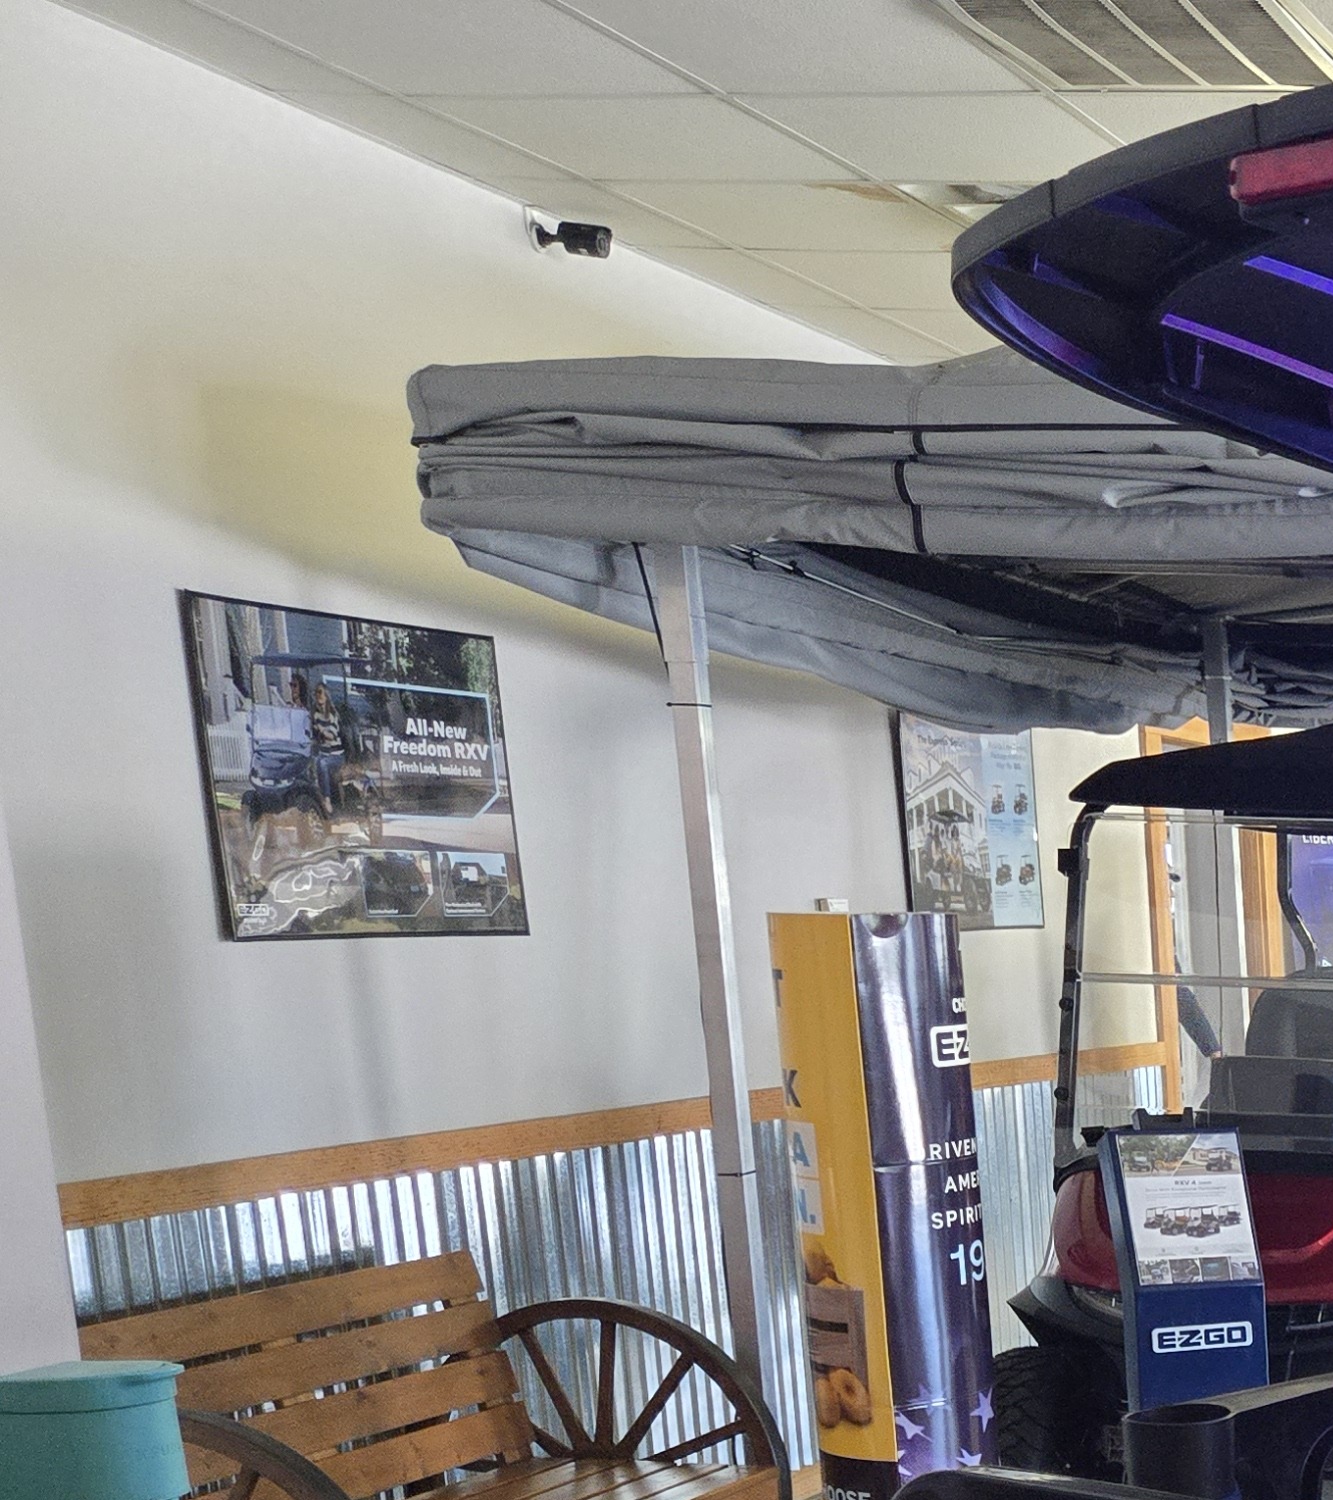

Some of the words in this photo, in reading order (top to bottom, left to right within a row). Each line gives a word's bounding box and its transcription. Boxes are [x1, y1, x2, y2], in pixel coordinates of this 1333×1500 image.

[405, 717, 468, 740] All-New
[383, 735, 452, 759] Freedom
[454, 742, 490, 761] RXV
[391, 760, 398, 773] A
[398, 761, 419, 774] Fresh
[440, 764, 462, 777] Inside
[469, 766, 482, 778] Out
[1157, 1325, 1247, 1350] EZGO
